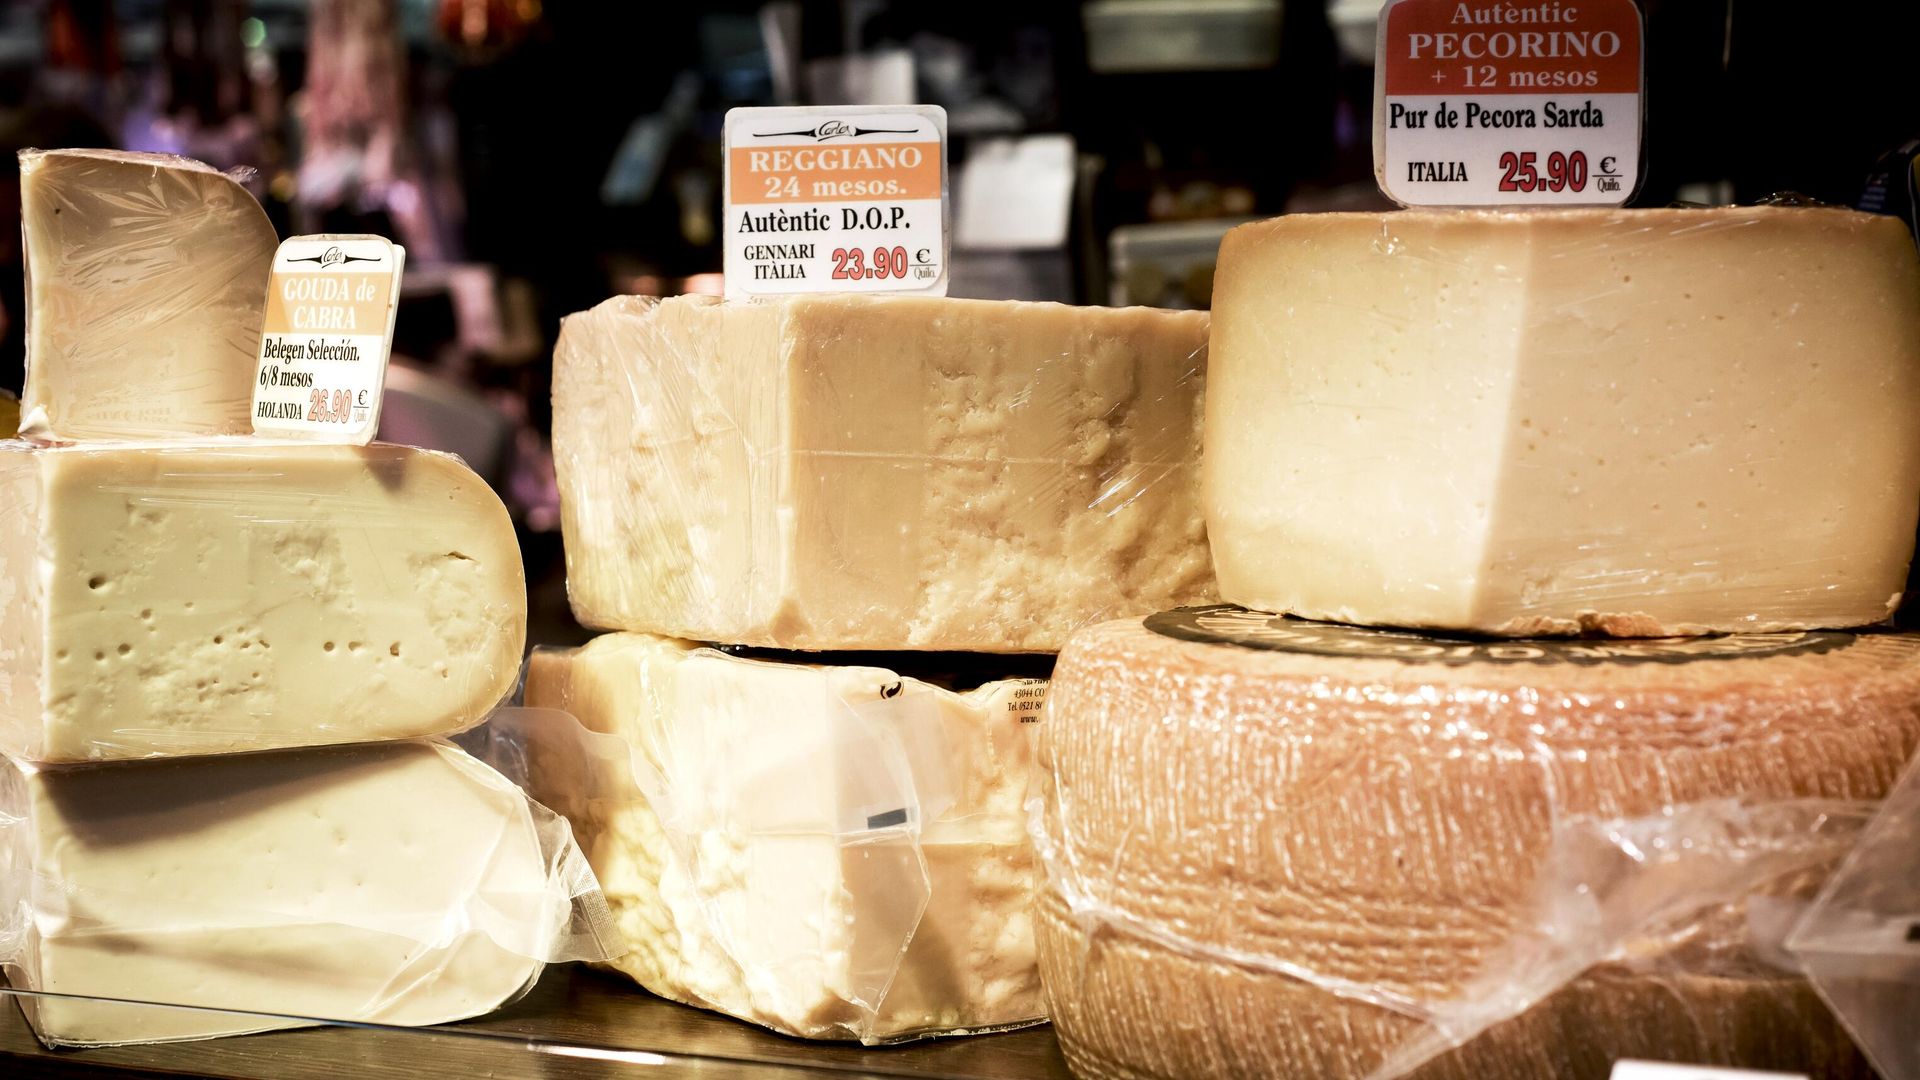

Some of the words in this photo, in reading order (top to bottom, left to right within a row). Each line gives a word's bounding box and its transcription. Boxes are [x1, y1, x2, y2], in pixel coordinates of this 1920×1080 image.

[1451, 1, 1578, 25] Autèntic
[1408, 31, 1621, 59] PECORINO
[1463, 65, 1497, 88] 12
[1509, 69, 1598, 87] mesos
[1390, 103, 1428, 129] Pur
[1434, 102, 1458, 129] de
[1465, 102, 1536, 129] Pecora
[1544, 101, 1604, 129] Sarda
[750, 146, 922, 173] REGGIANO
[1407, 161, 1468, 182] ITALIA
[1498, 150, 1588, 193] 25.90
[1599, 156, 1617, 174] €
[764, 175, 801, 198] 24
[812, 178, 907, 197] mesos.
[738, 207, 830, 233] Autèntic
[841, 206, 911, 230] D.O.P.
[744, 243, 815, 261] GENNARI
[831, 245, 908, 280] 23.90
[915, 248, 931, 264] €
[754, 262, 807, 280] ITÀLIA
[284, 277, 351, 302] GOUDA
[355, 277, 376, 302] de
[293, 305, 357, 330] CABRA
[263, 337, 304, 365] Belegen
[306, 337, 360, 362] Selección.
[260, 365, 278, 390] 6/8
[280, 372, 313, 388] mesos
[257, 401, 302, 420] HOLANDA
[307, 388, 352, 424] 26.90
[358, 389, 368, 406] €
